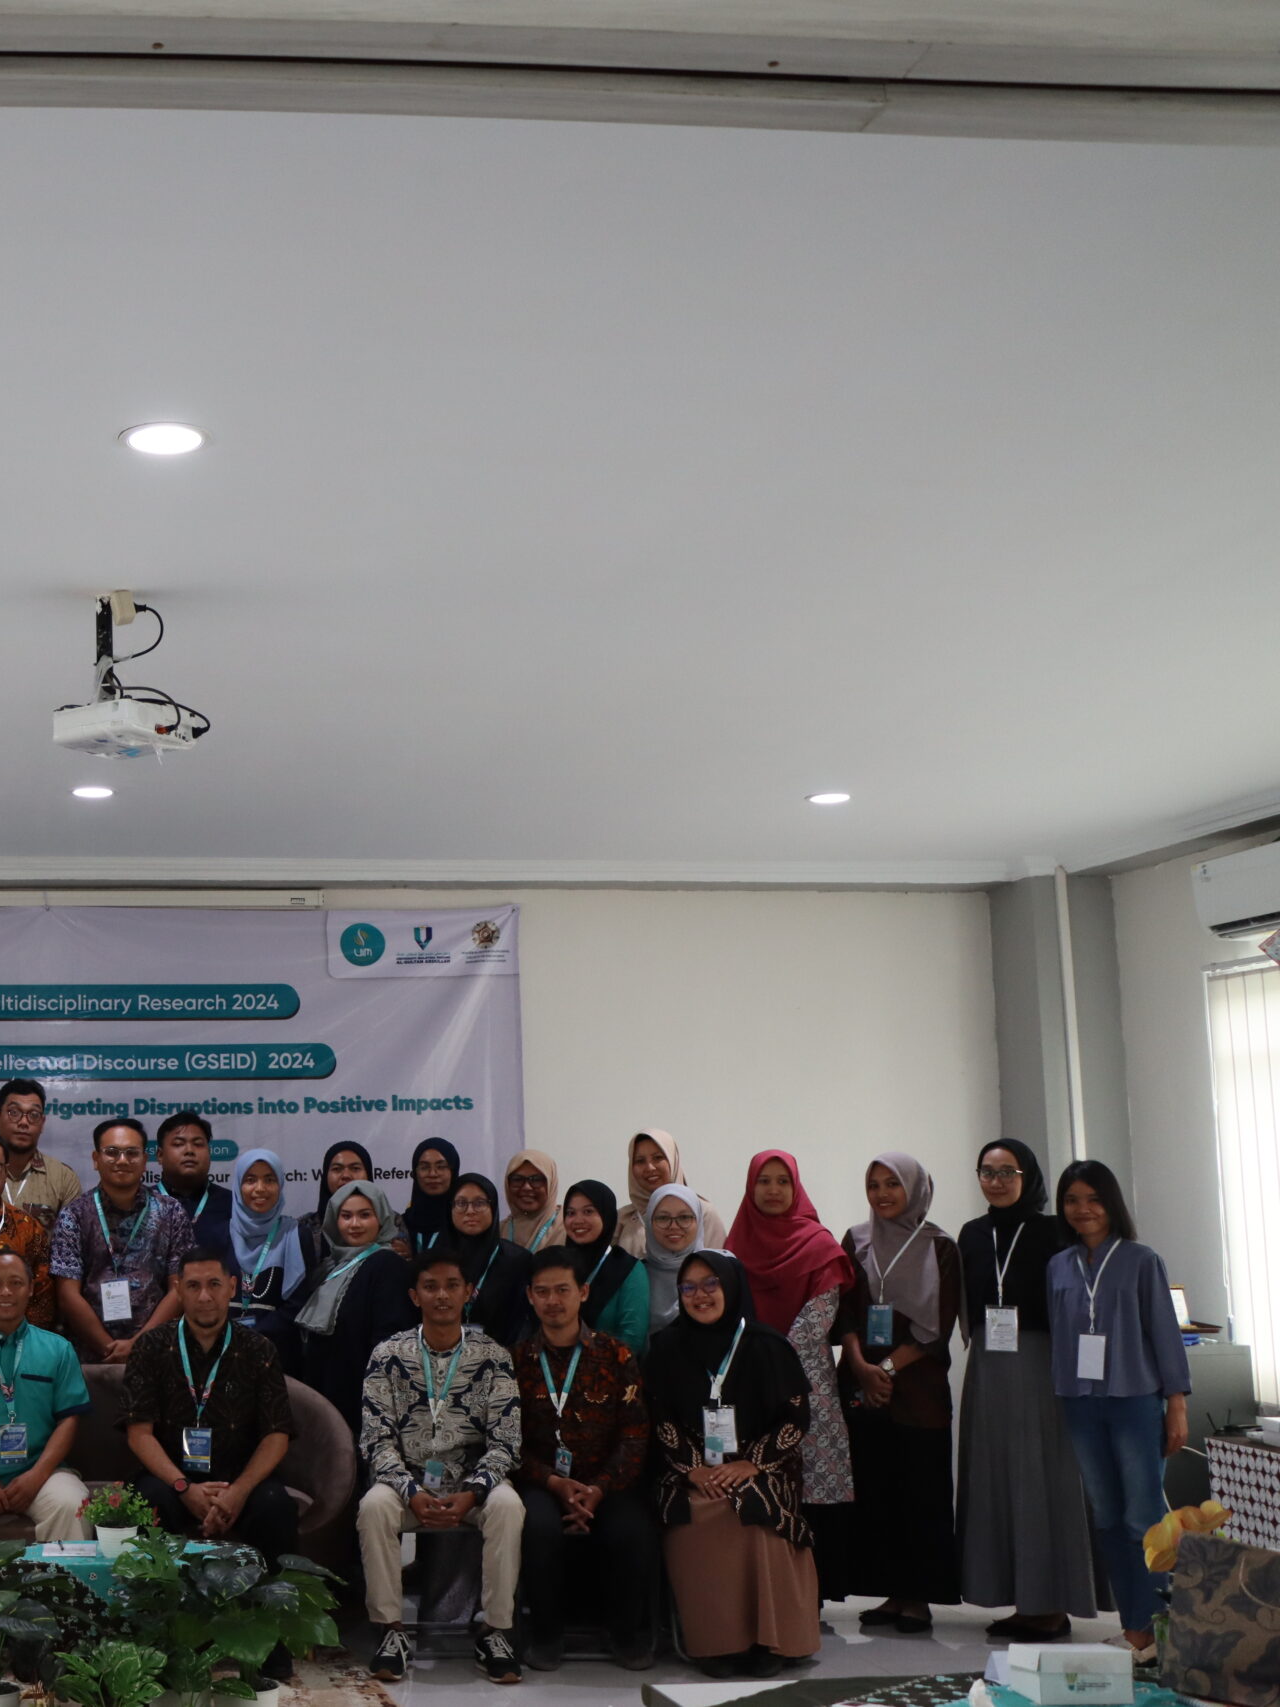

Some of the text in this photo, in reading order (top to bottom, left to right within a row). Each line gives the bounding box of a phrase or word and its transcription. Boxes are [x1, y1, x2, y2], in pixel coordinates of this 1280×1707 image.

[138, 994, 227, 1011] Research
[231, 994, 280, 1011] 2024
[83, 1054, 179, 1071] Discourse
[185, 1051, 257, 1072] (GSEID)
[268, 1053, 315, 1069] 2024
[43, 1098, 130, 1119] vigating
[134, 1098, 253, 1115] Disruptions
[257, 1097, 299, 1114] into
[303, 1095, 388, 1114] Positive
[392, 1095, 474, 1115] Impacts
